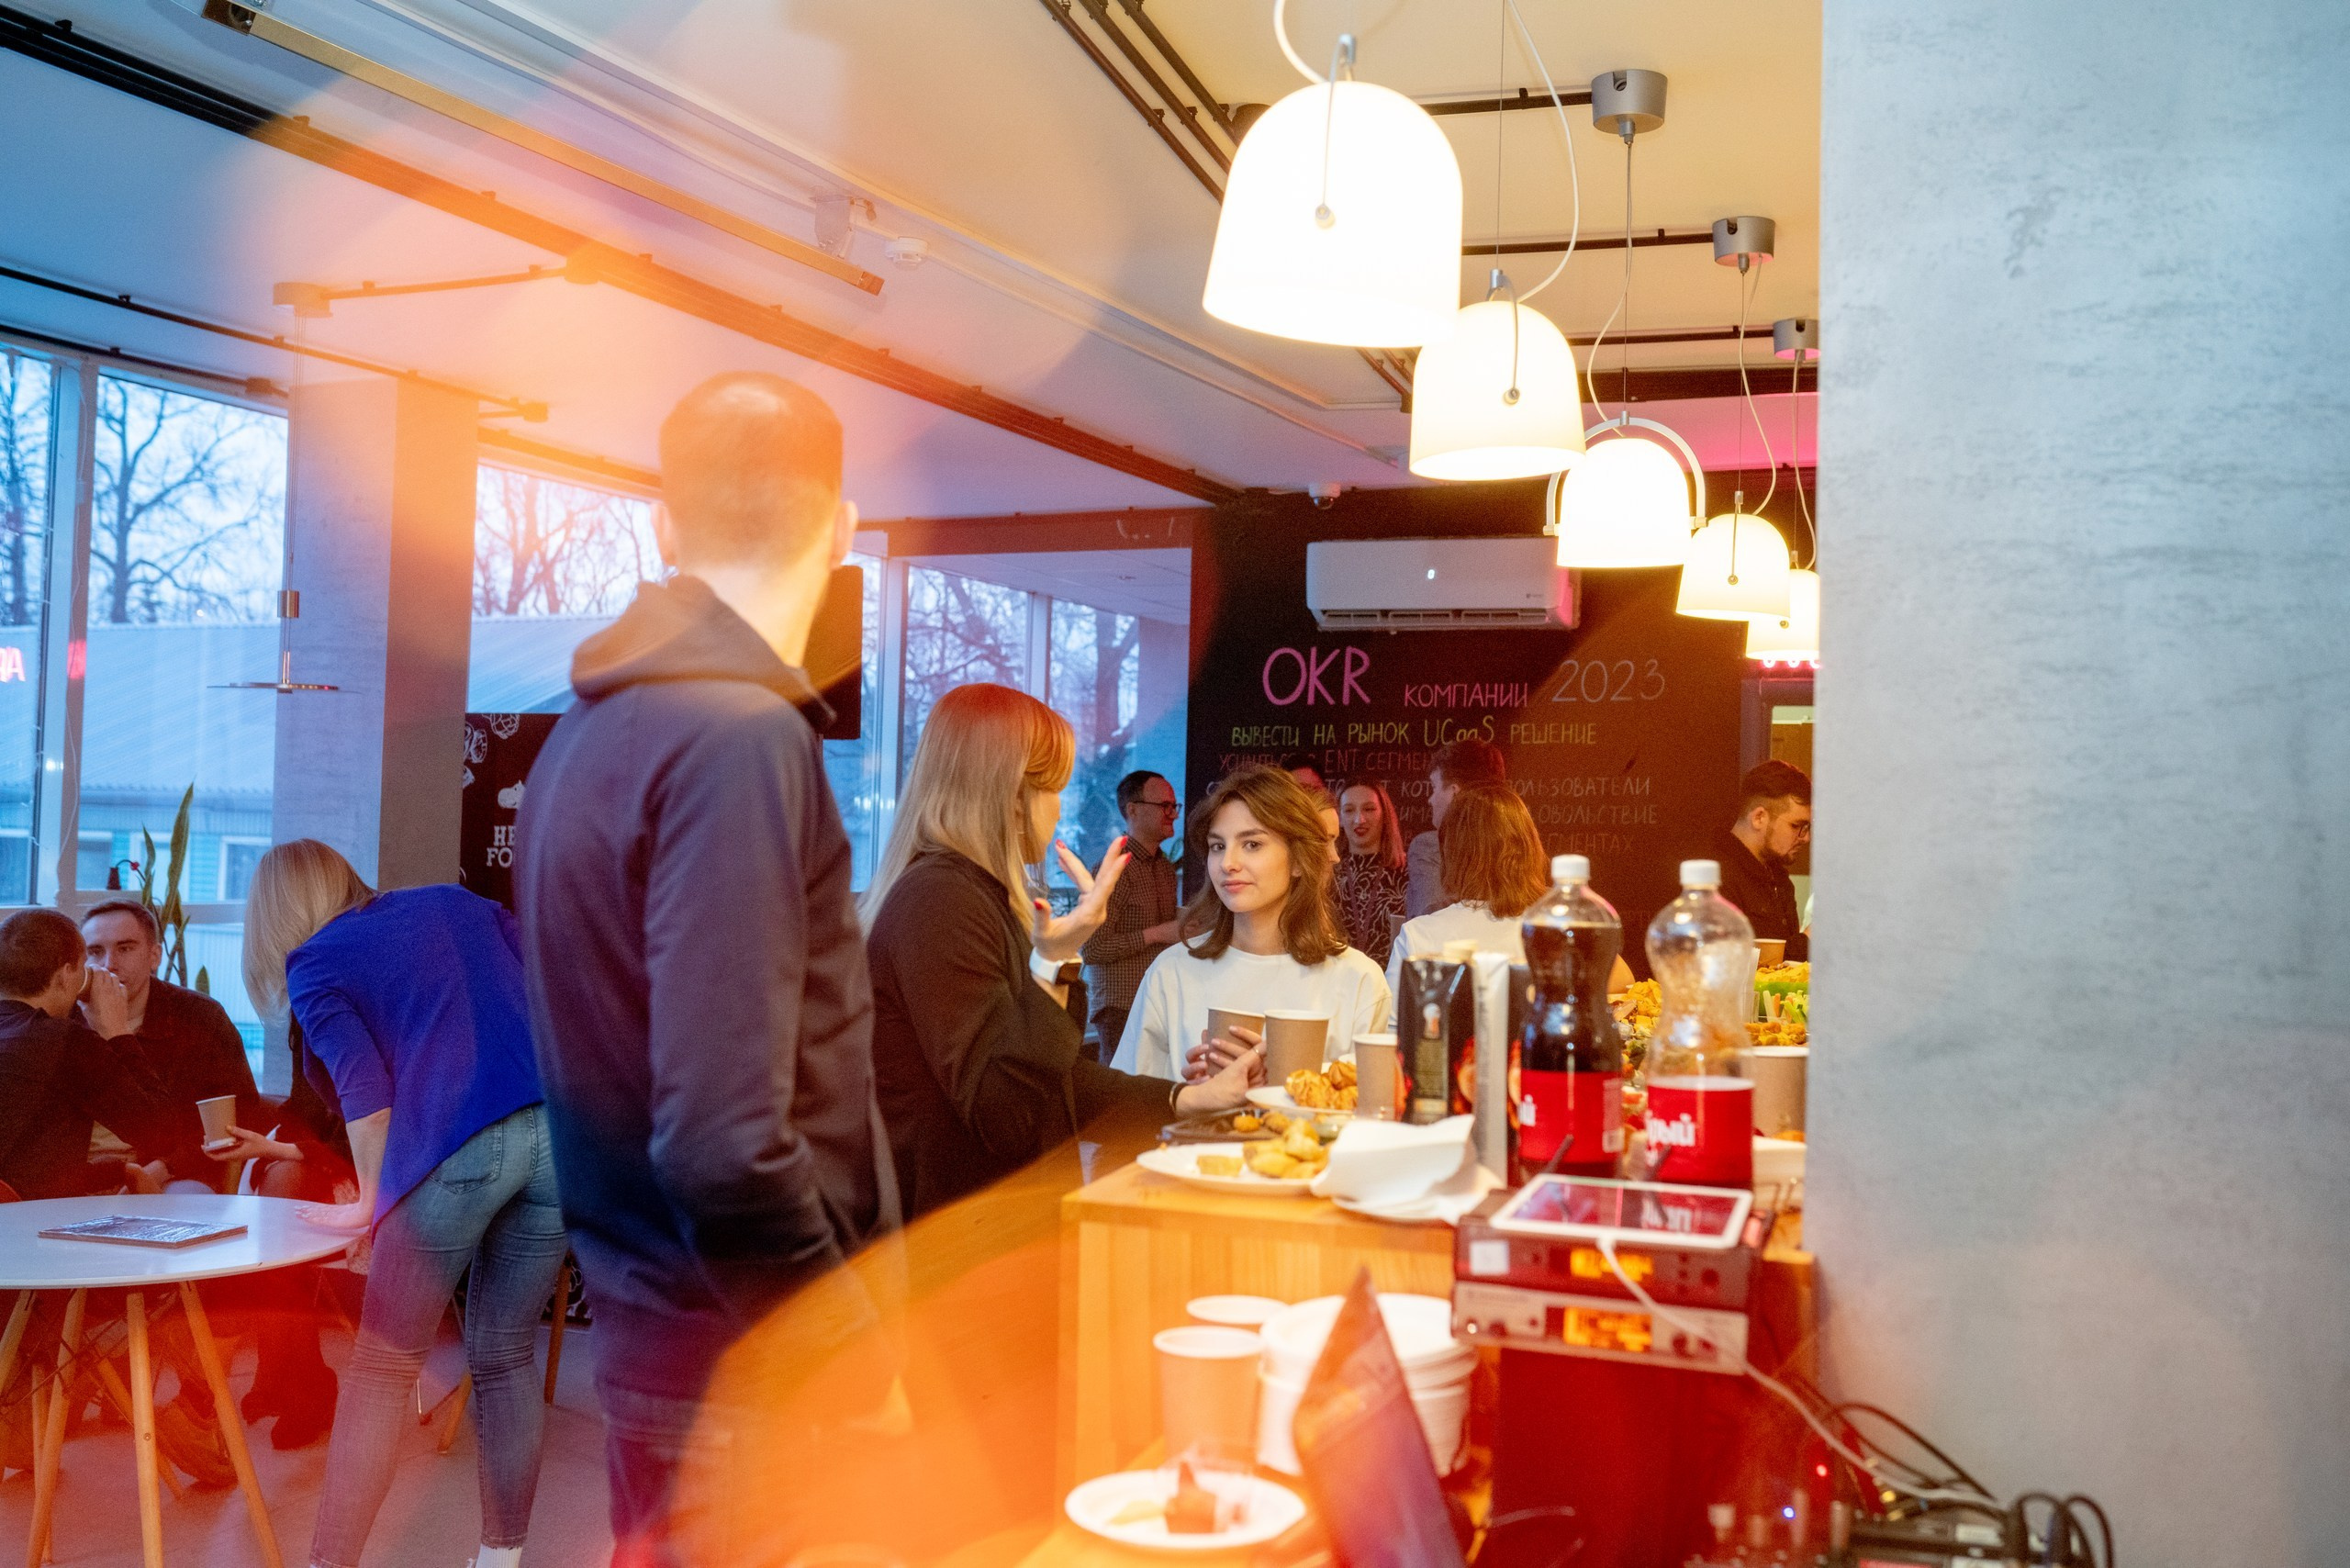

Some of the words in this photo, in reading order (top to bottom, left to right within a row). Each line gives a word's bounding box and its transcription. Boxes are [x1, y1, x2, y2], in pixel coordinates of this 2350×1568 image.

[1262, 645, 1371, 706] OKR
[1404, 682, 1528, 708] КОМПАНИИ
[1551, 658, 1665, 703] 2023
[1231, 725, 1300, 747] ВЫВЕСТИ
[1313, 723, 1337, 745] НА
[1348, 722, 1410, 745] РЫНОК
[1510, 722, 1597, 745] РЕШЕНИЕ
[1325, 747, 1360, 774] ENT
[1538, 803, 1659, 824] ОВОЛЬСТВИЕ
